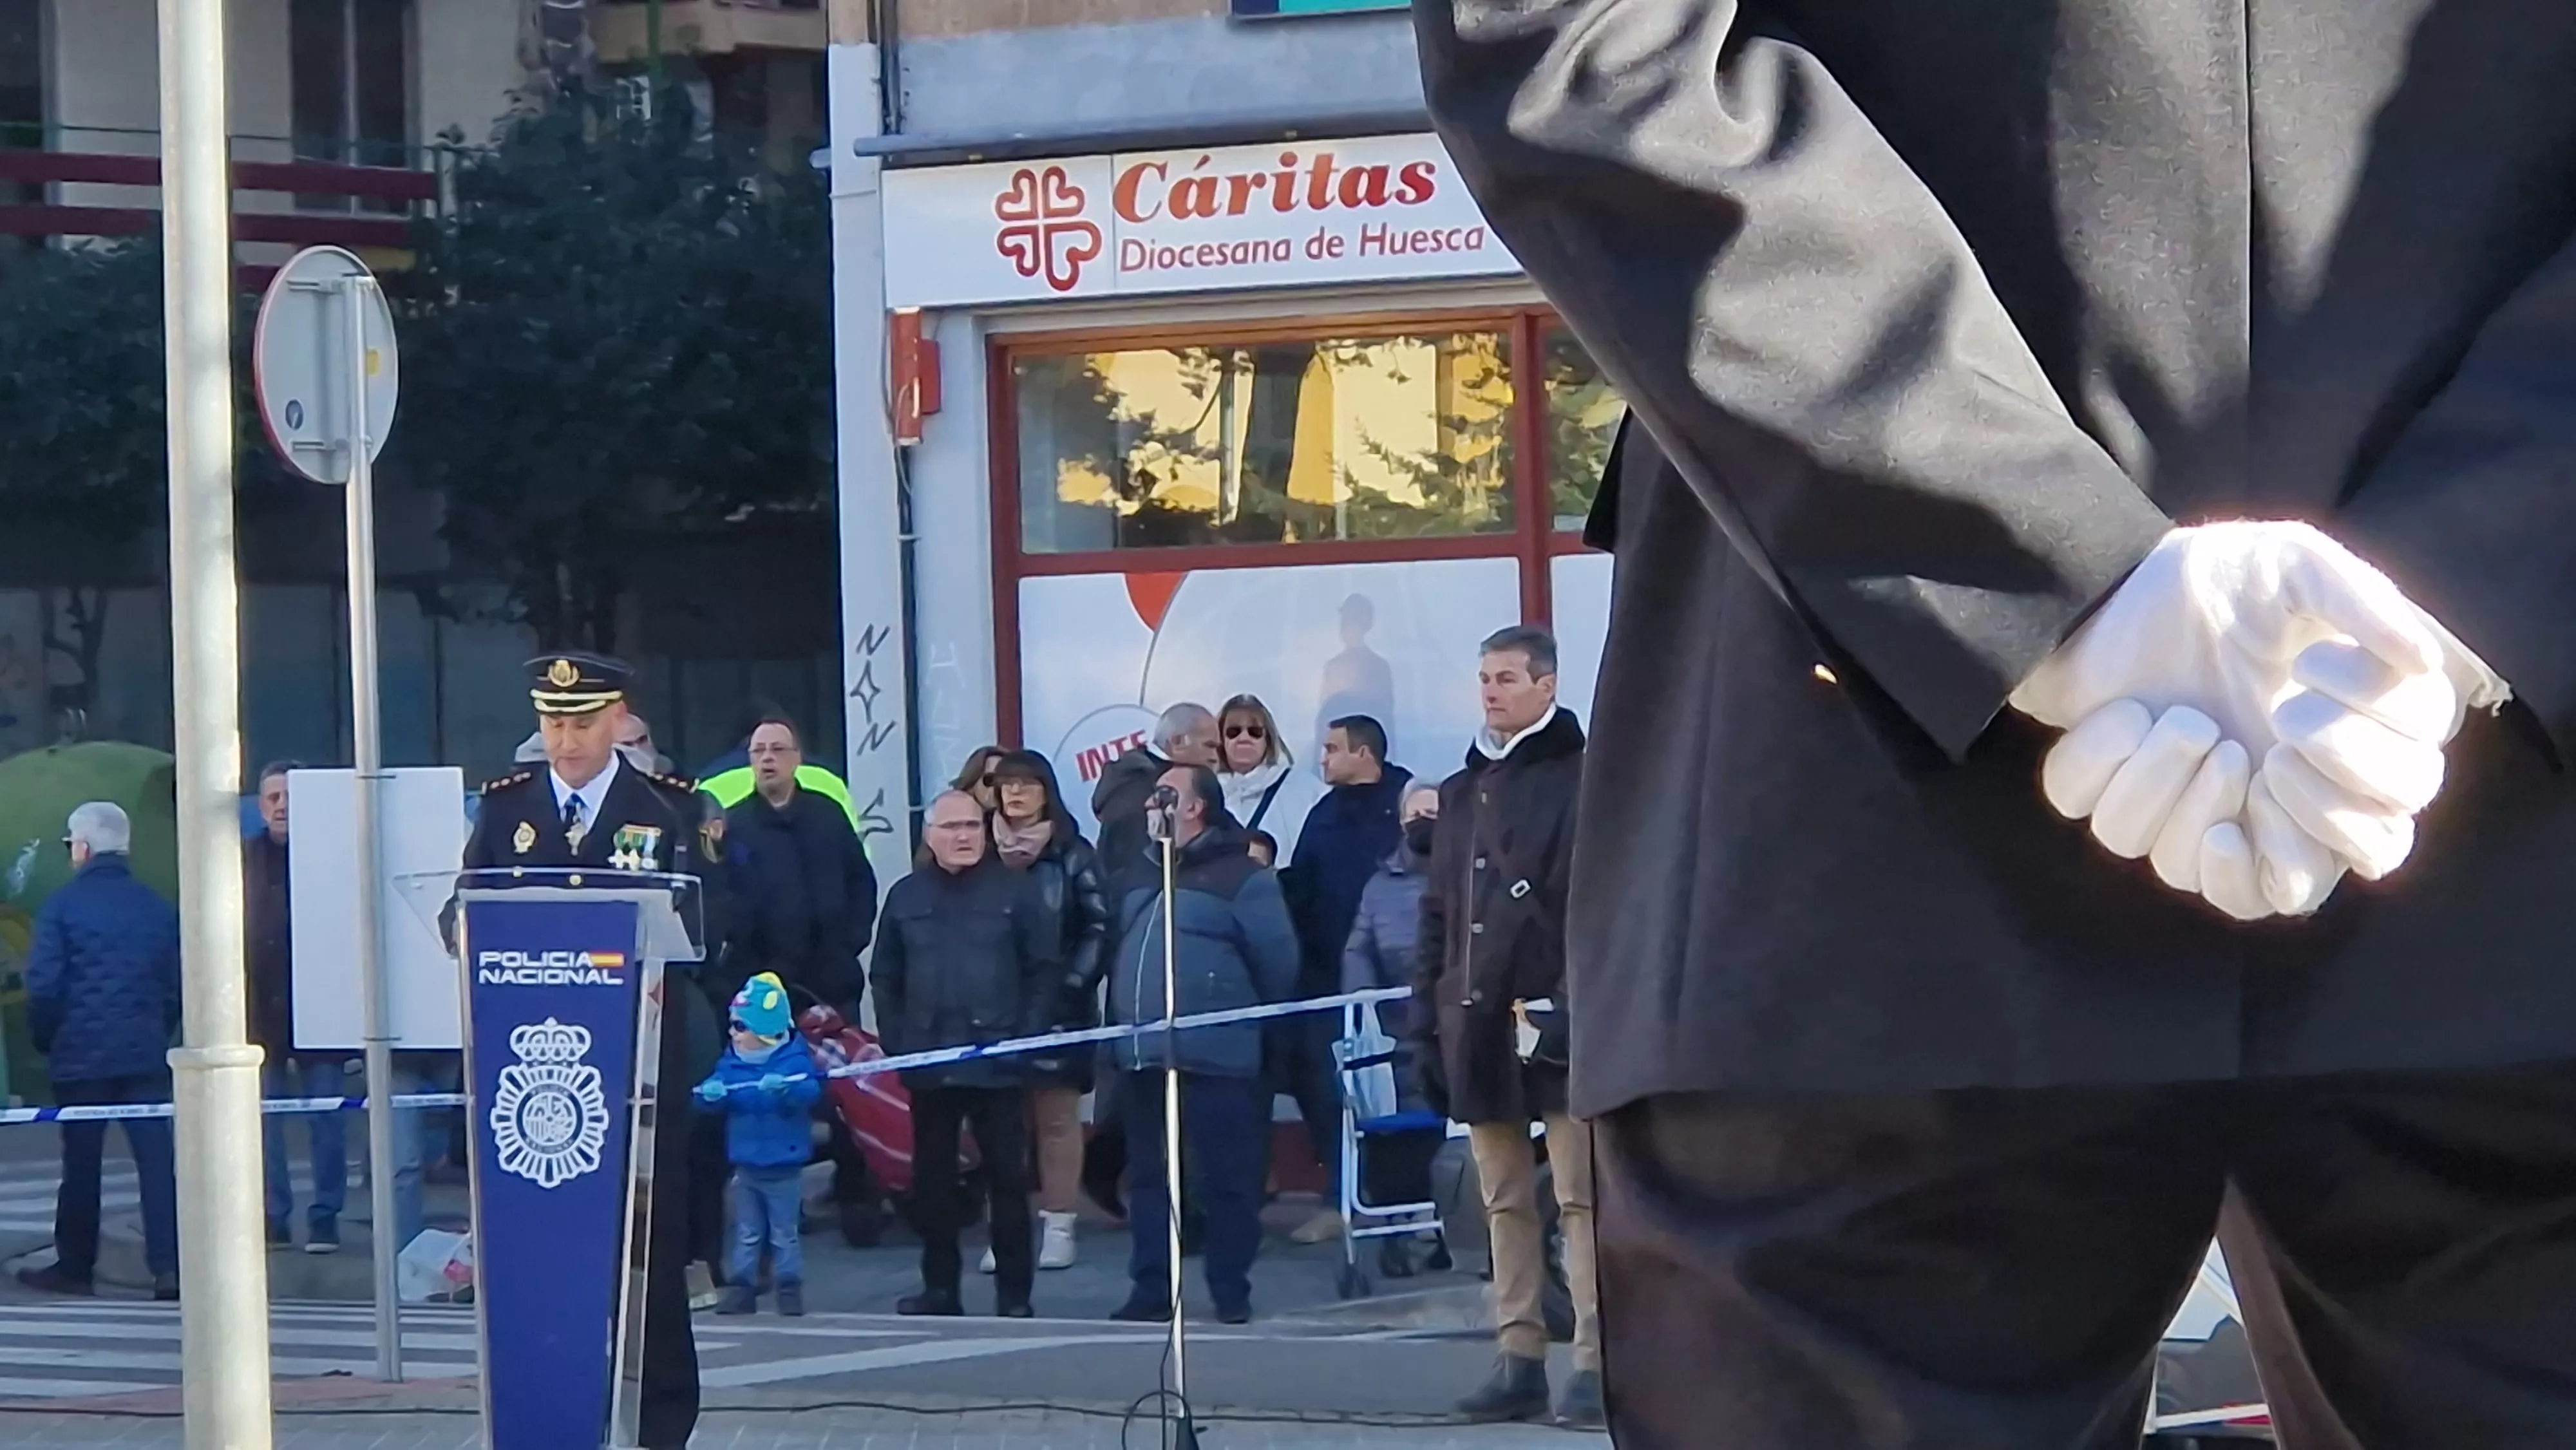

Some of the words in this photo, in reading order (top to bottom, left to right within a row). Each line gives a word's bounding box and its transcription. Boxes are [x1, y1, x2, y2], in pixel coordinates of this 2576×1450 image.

[1112, 152, 1436, 223] Cáritas
[1120, 238, 1291, 272] Diocesana
[1305, 225, 1345, 259] de
[1359, 221, 1484, 256] Huesca
[479, 951, 593, 967] POLICIA
[478, 968, 623, 985] NACIONAL
